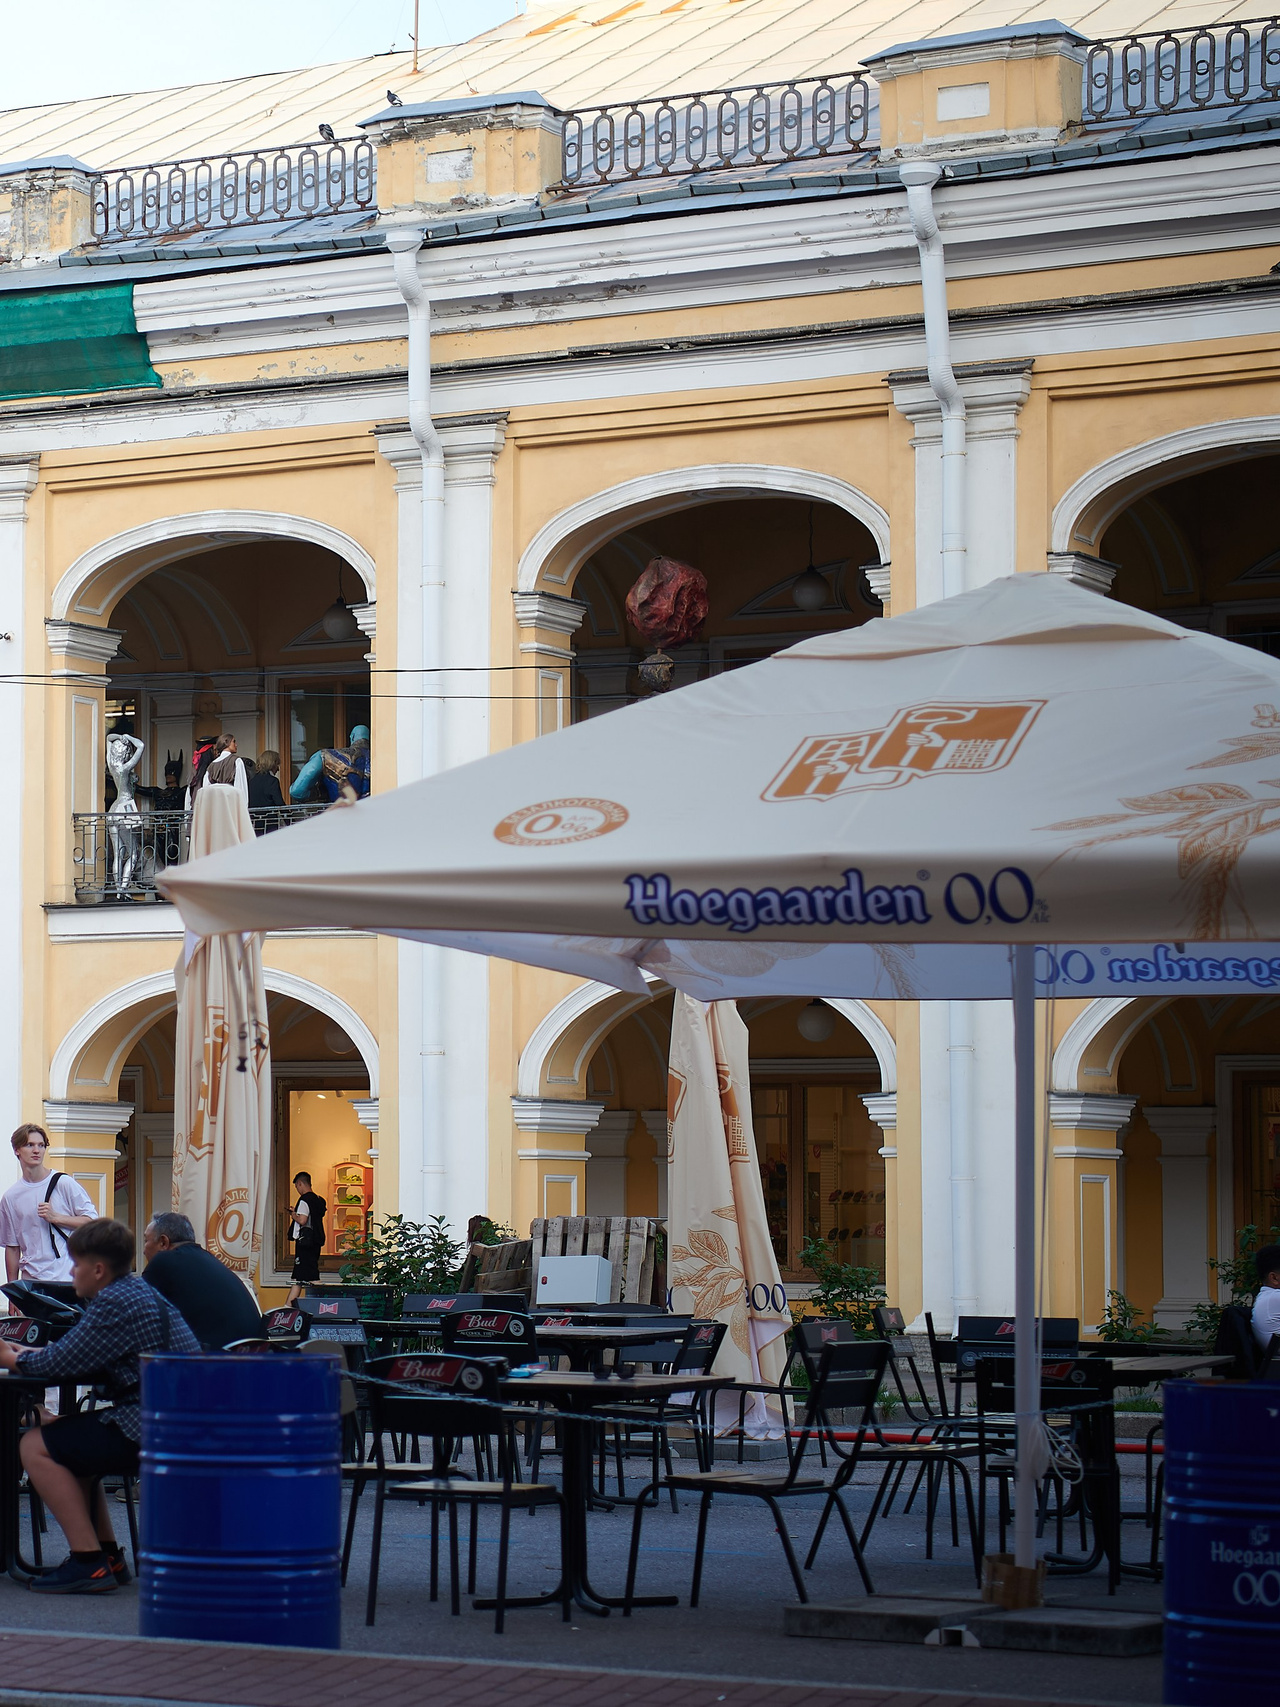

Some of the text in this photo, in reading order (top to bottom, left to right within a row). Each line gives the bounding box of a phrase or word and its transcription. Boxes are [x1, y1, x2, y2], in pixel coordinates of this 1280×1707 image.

[623, 868, 933, 933] Hoegaarden
[208, 1238, 249, 1271] ПРОДУКЦ
[274, 1311, 292, 1325] Bud
[464, 1314, 498, 1329] Bud
[397, 1360, 445, 1379] Bud
[1041, 1365, 1058, 1375] ud
[1210, 1541, 1280, 1568] Hoegaar
